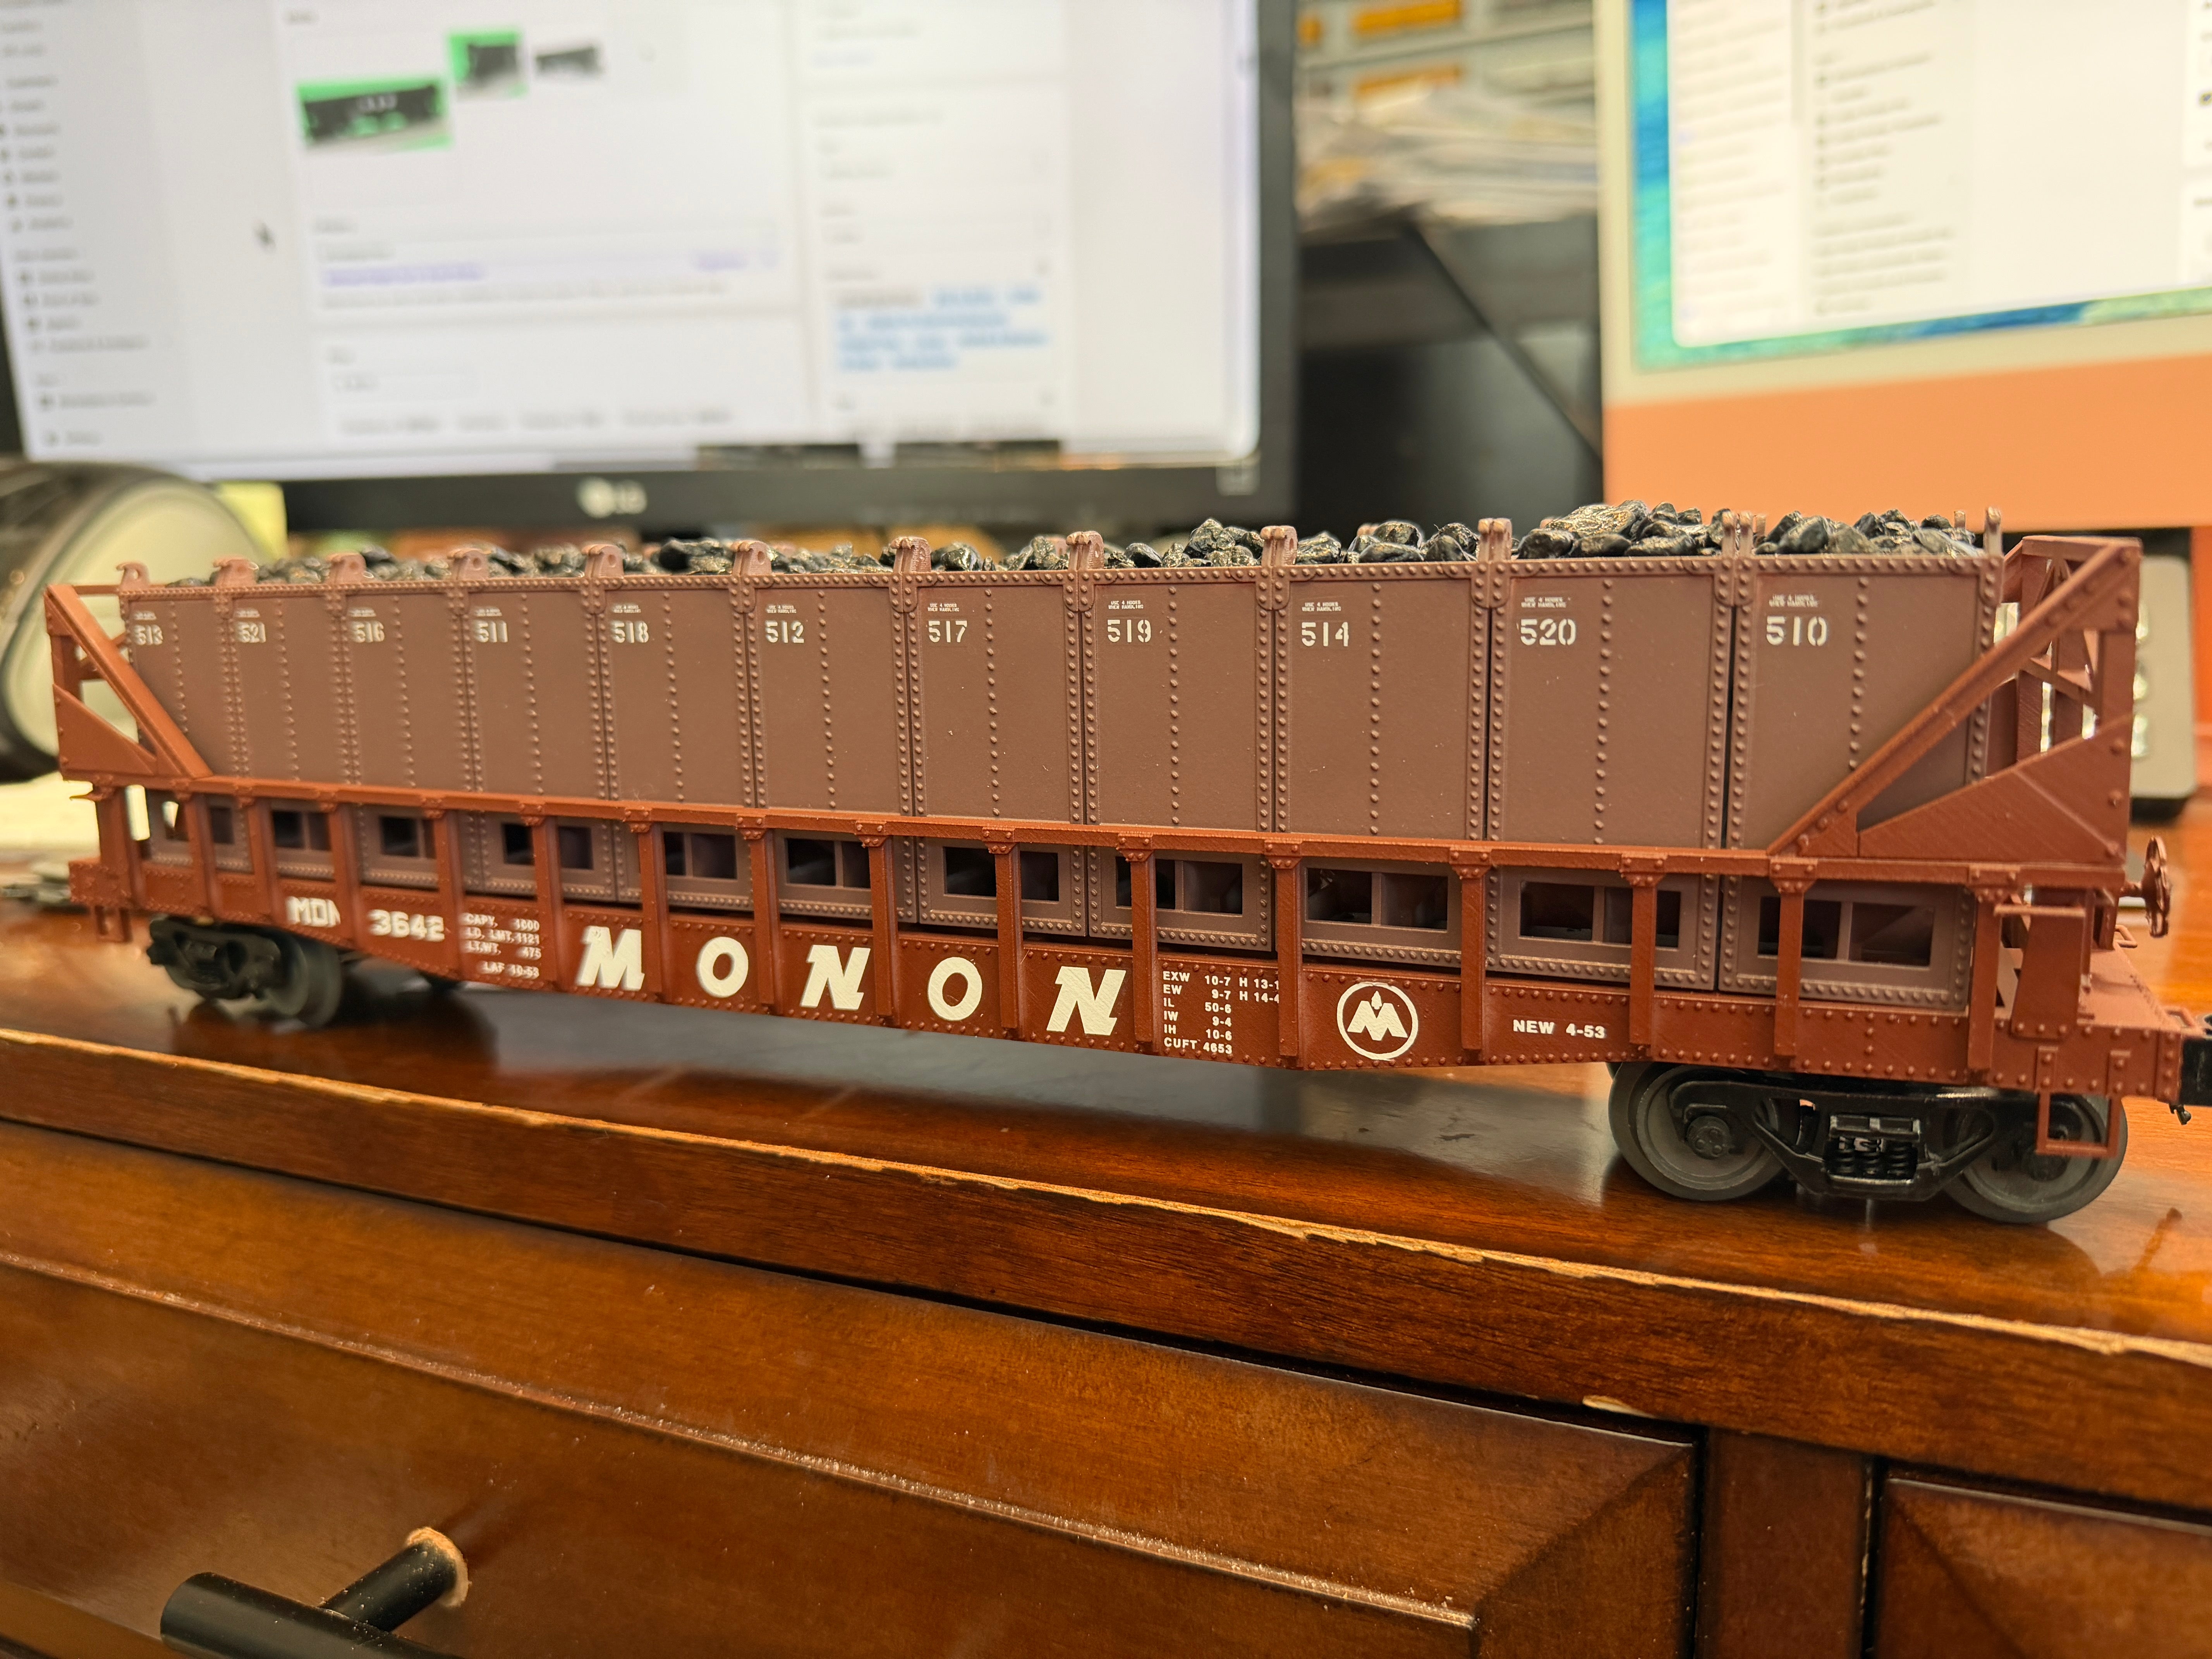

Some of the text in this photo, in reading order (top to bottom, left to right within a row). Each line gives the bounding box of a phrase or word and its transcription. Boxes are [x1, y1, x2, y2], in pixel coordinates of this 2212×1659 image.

[234, 621, 266, 643] 521
[350, 620, 385, 643] 516
[473, 620, 508, 643] 511
[612, 620, 649, 643] 518
[765, 620, 805, 643] 512
[928, 620, 967, 643] 517
[1107, 619, 1151, 643] 519
[1302, 622, 1349, 647] 514
[1520, 618, 1576, 646] 520
[1766, 616, 1827, 646] 510
[367, 908, 445, 942] 3642
[576, 926, 1126, 1036] MONON
[1163, 970, 1190, 982] EXW
[1204, 975, 1231, 986] 10-7
[1239, 977, 1248, 988] H
[1163, 984, 1182, 995] EW
[1211, 989, 1231, 1000] 9-7
[1239, 990, 1248, 1001] H
[1163, 997, 1231, 1014] IL 50-6
[1164, 1010, 1232, 1027] IW 9-4
[1513, 1019, 1607, 1039] NEW 4-53
[1164, 1024, 1232, 1041] IH 10-6
[1164, 1037, 1232, 1054] CUFT 4653
